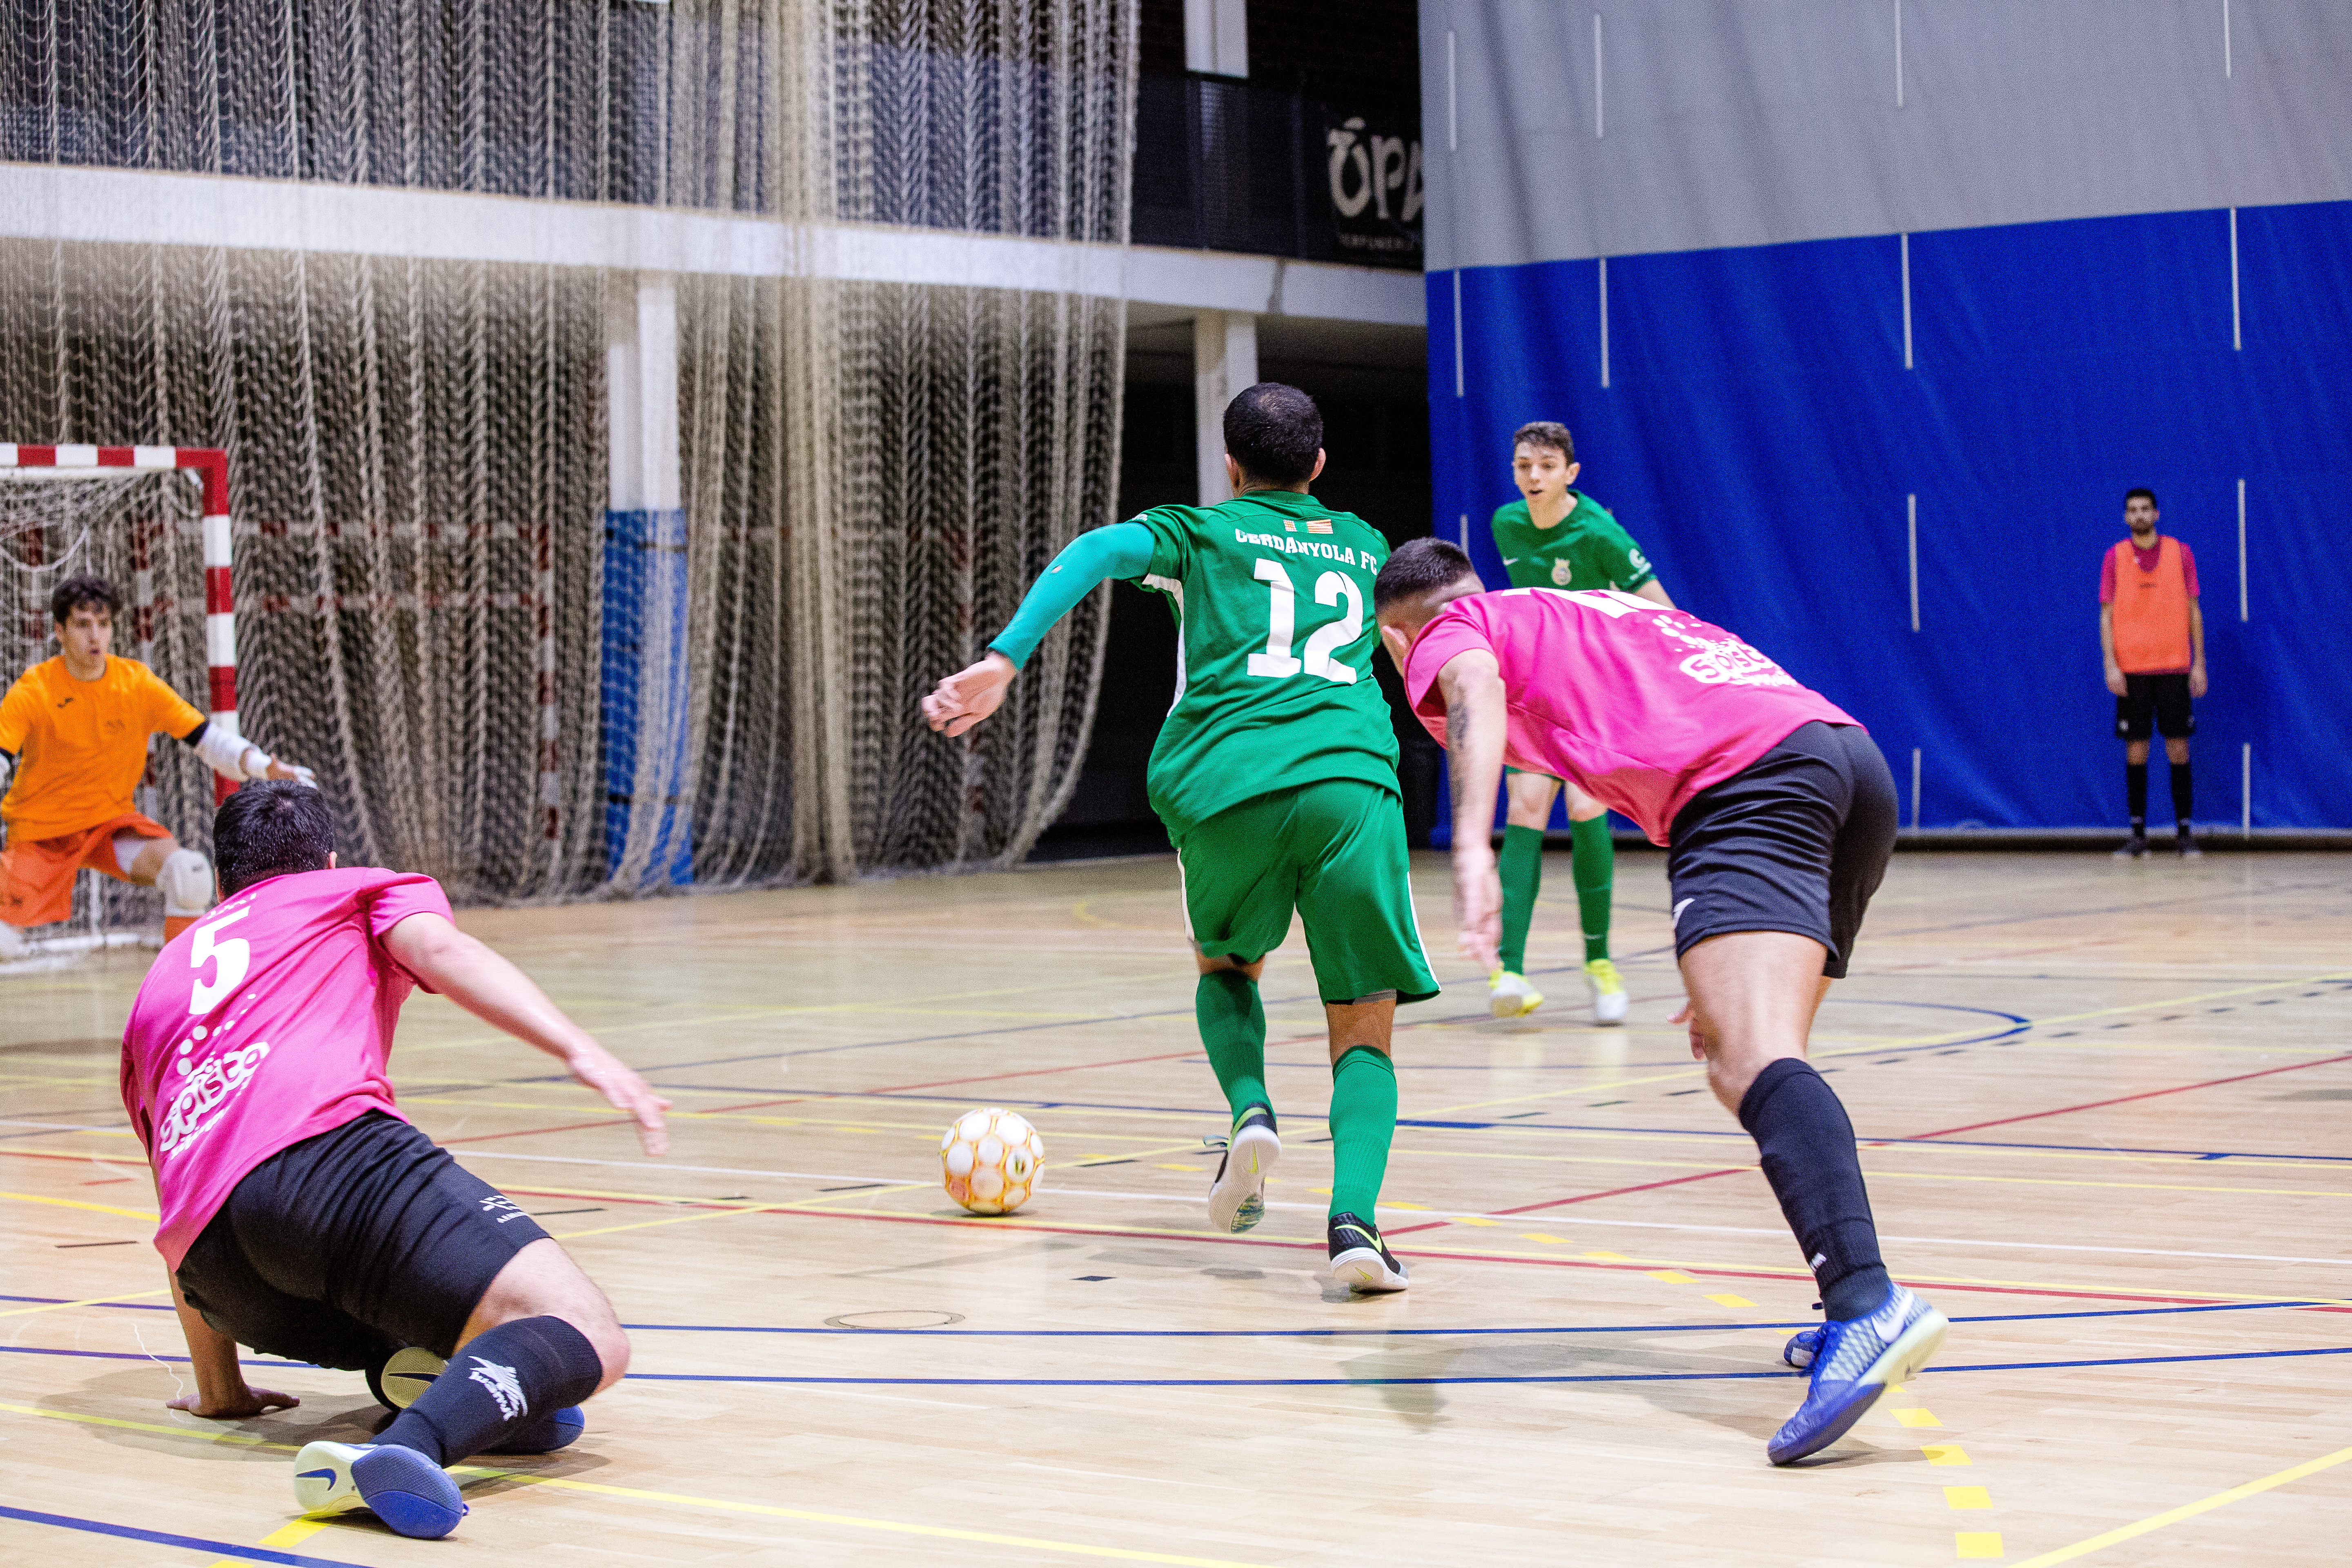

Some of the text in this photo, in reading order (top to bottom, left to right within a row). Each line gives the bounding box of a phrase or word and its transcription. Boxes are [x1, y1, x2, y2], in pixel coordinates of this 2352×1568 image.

[1360, 550, 1377, 576] FC
[1247, 558, 1363, 685] 12
[189, 905, 251, 1015] 5
